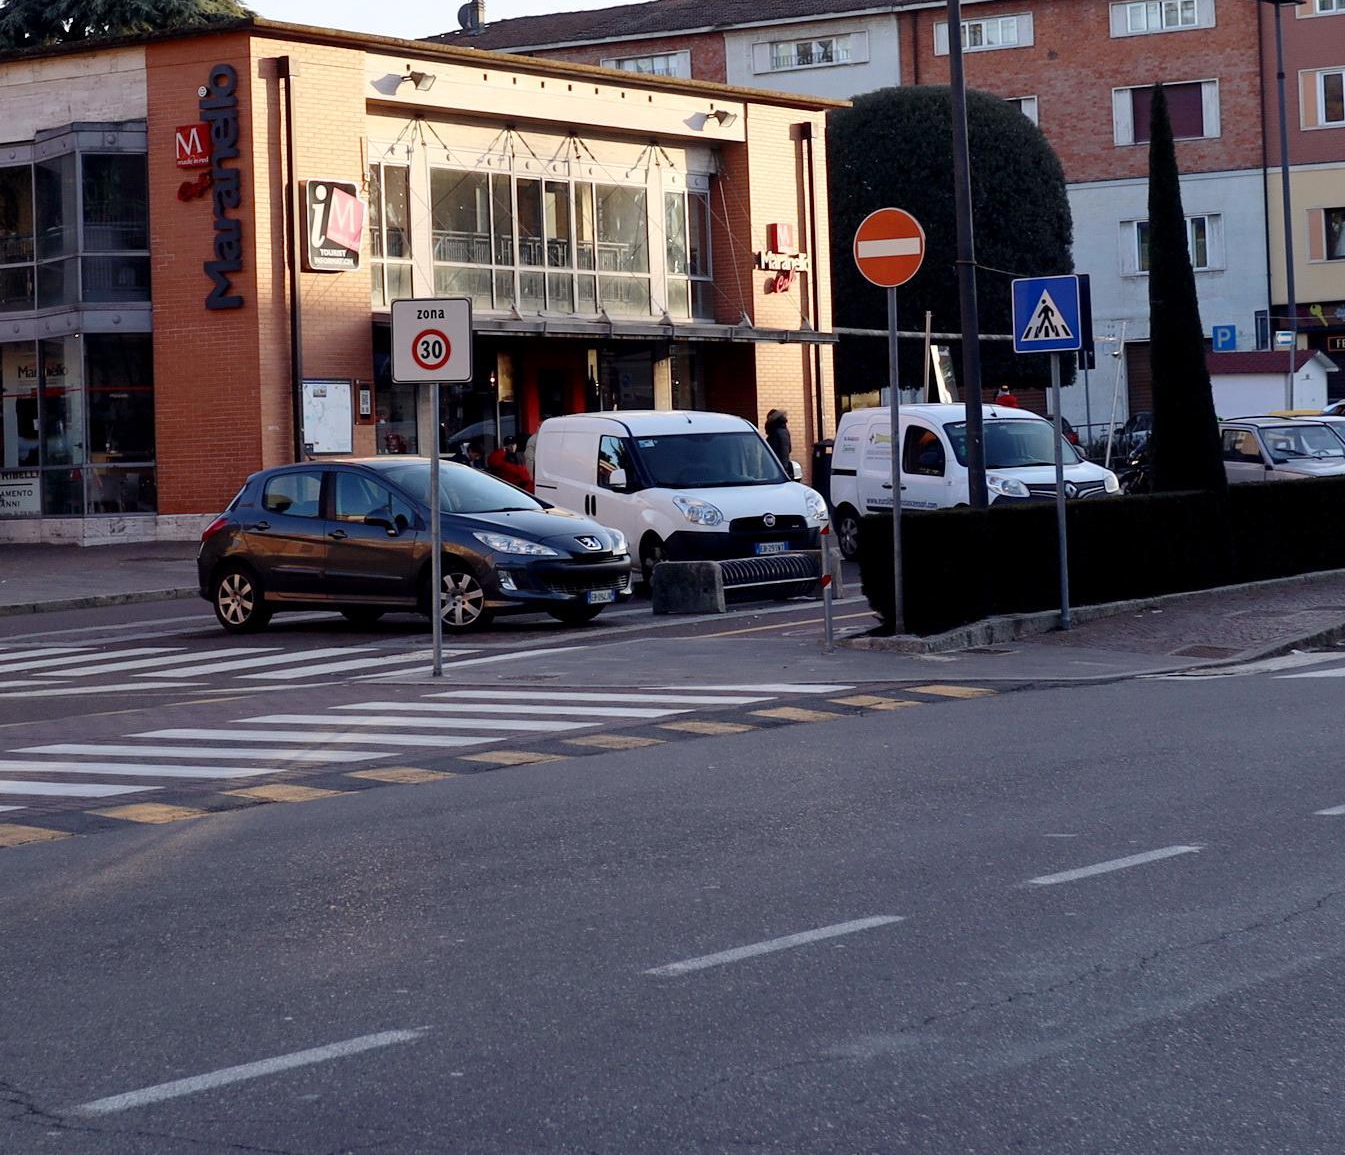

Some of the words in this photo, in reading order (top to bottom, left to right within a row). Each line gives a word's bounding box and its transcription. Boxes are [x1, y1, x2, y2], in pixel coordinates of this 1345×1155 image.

[176, 128, 203, 159] M
[199, 63, 244, 311] Maranello
[320, 248, 347, 257] TOURIST
[760, 250, 810, 272] Maranello
[416, 308, 445, 320] zona
[1217, 328, 1232, 349] P
[420, 340, 443, 360] 30
[0, 499, 21, 509] ANNI
